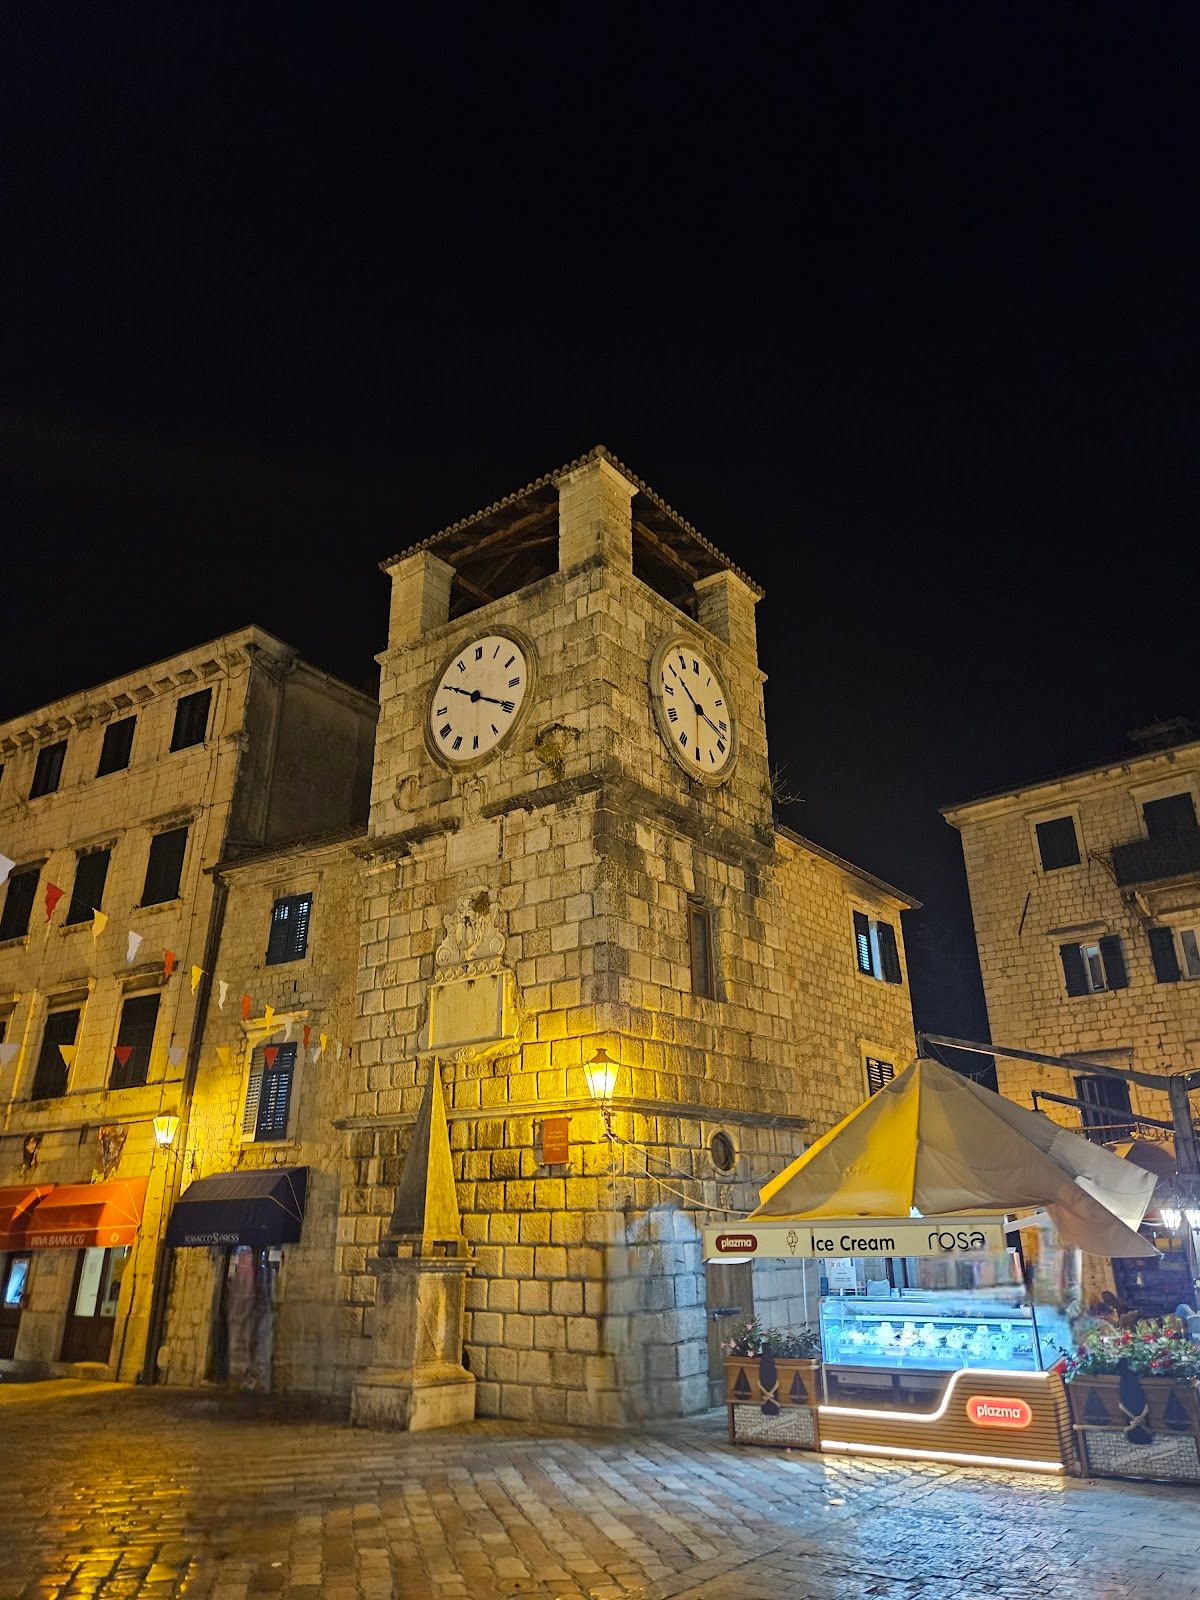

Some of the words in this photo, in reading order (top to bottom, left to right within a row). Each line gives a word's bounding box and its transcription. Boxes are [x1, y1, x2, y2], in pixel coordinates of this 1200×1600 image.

[48, 1235, 72, 1246] BANKA
[73, 1234, 85, 1245] CG
[721, 1237, 753, 1250] plazma
[811, 1235, 834, 1251] Ice
[840, 1235, 895, 1251] Cream
[928, 1231, 986, 1251] rosa
[976, 1403, 1022, 1419] plazma
